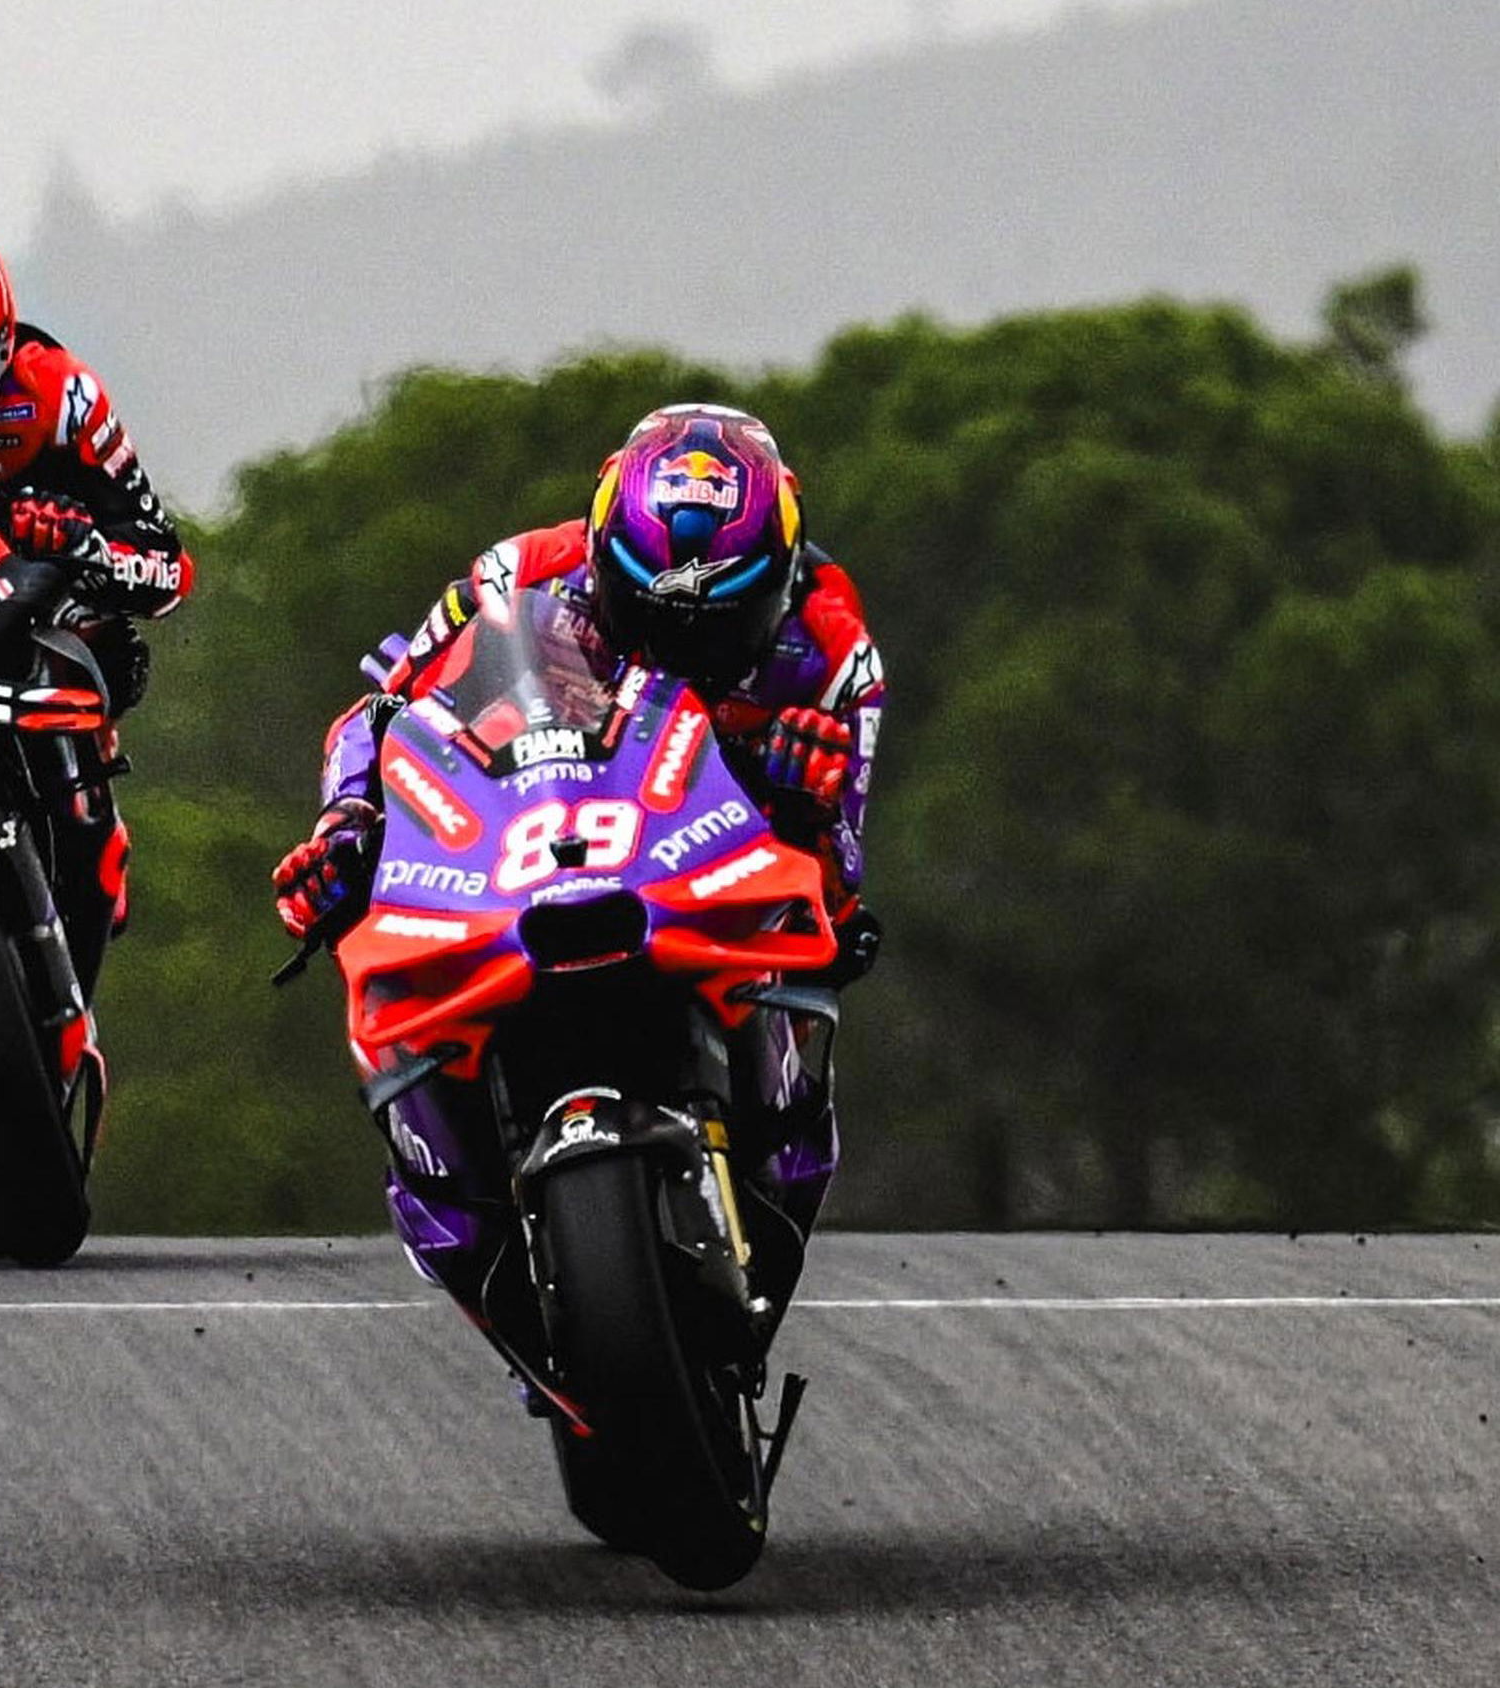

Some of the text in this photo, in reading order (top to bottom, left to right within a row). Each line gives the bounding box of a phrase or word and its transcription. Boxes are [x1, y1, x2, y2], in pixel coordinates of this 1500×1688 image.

[112, 549, 182, 591] aprilia
[513, 729, 586, 768] FIAMM
[513, 762, 593, 796] prima
[497, 799, 640, 892] 89
[650, 799, 750, 872] prima
[380, 859, 489, 897] prima
